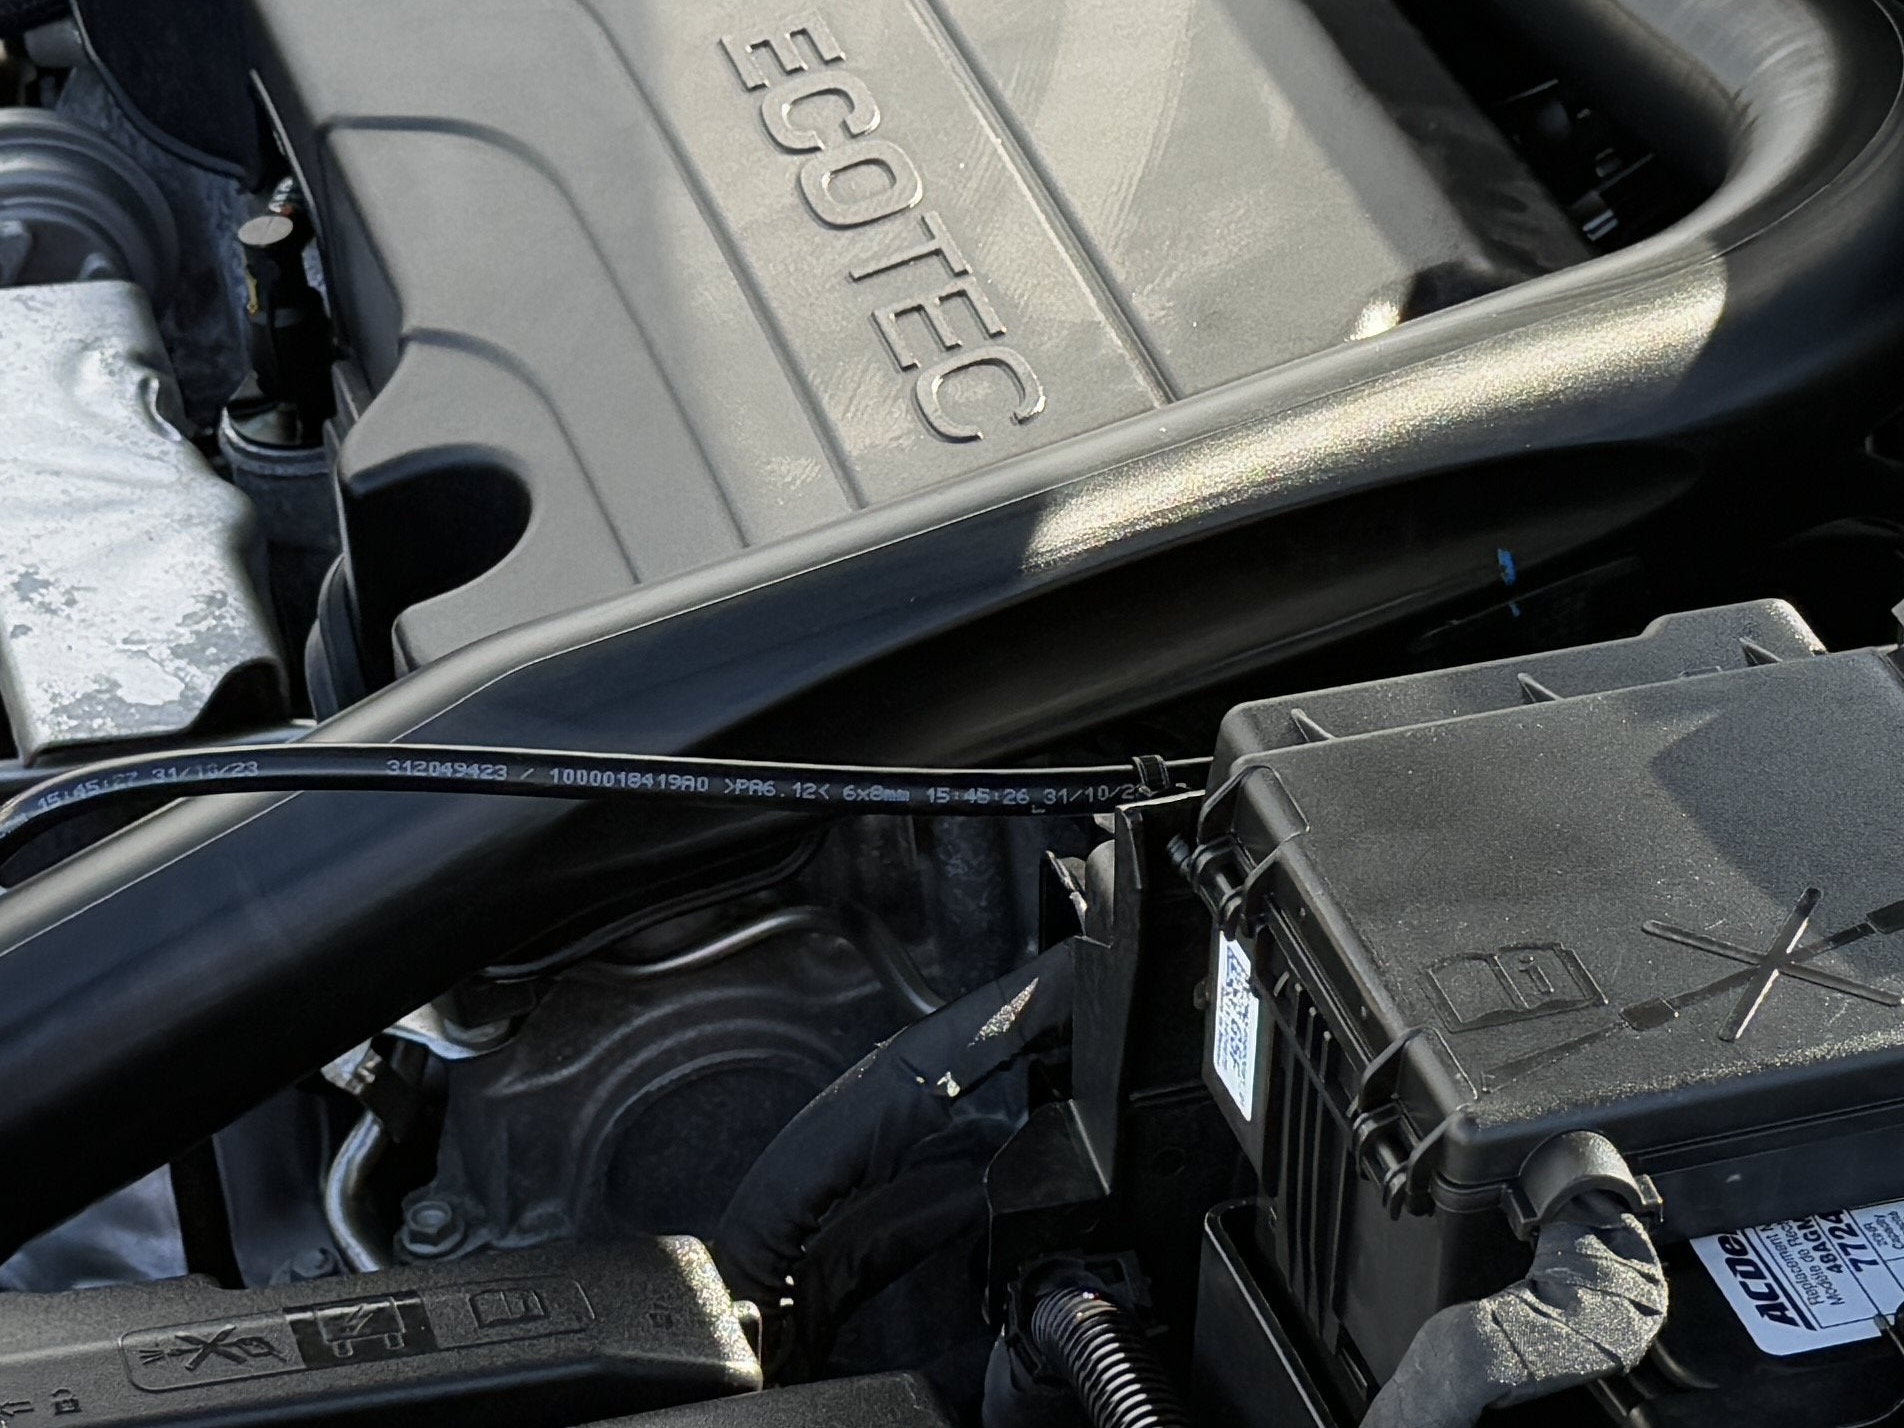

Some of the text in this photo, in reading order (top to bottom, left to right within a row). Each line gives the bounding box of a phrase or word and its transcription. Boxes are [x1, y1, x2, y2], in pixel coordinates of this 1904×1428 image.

[717, 9, 1048, 443] ECOTEC
[385, 759, 508, 781] 312049423
[925, 785, 1031, 805] 15:45:26
[1717, 1232, 1802, 1329] ACDe
